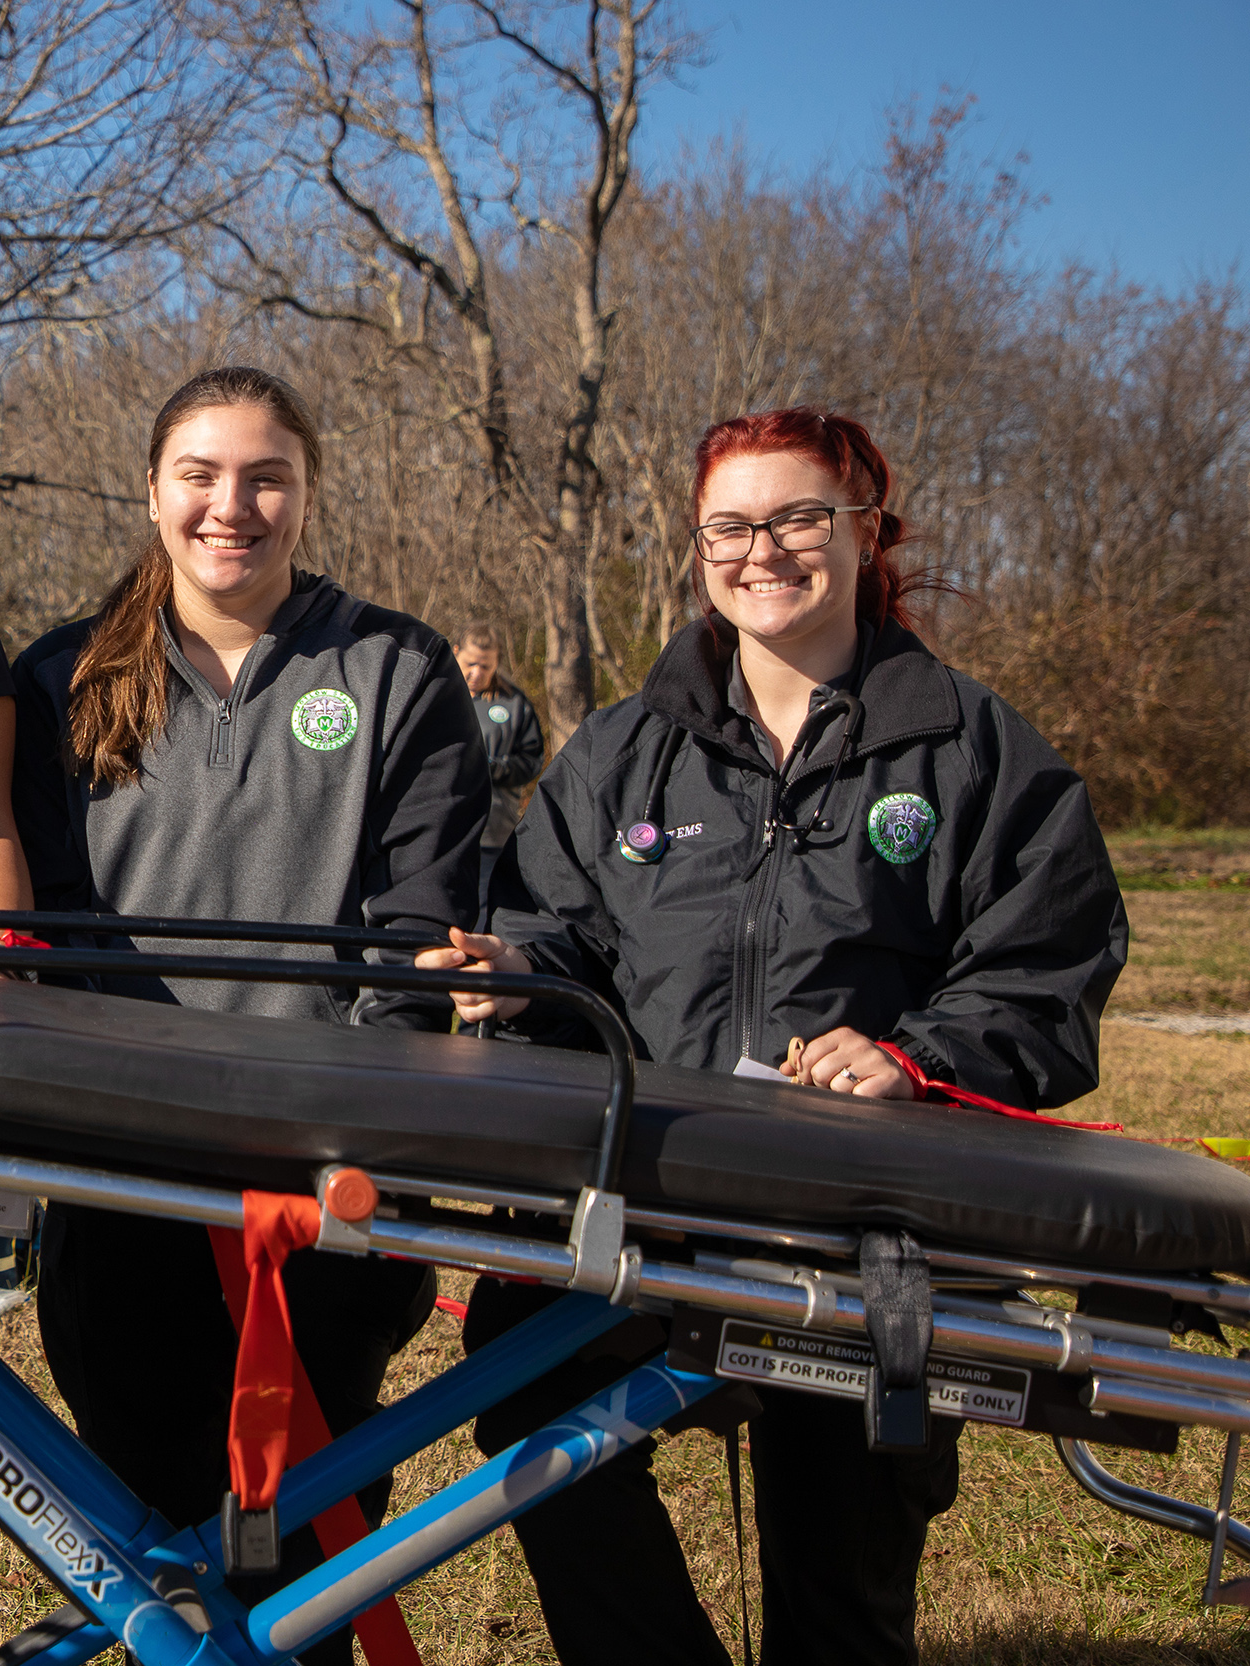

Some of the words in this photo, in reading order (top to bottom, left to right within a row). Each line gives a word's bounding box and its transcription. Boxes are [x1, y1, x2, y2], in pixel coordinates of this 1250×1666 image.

[319, 718, 330, 728] M
[676, 822, 703, 839] EMS
[896, 826, 908, 839] M
[777, 1336, 796, 1349] DO
[798, 1339, 825, 1354] NOT
[926, 1362, 945, 1374] ND
[947, 1366, 991, 1382] GUARD
[728, 1352, 759, 1368] COT
[761, 1356, 777, 1371] IS
[779, 1360, 812, 1378] FOR
[815, 1366, 866, 1386] PROFE
[938, 1388, 970, 1405] USE
[972, 1393, 1016, 1413] ONLY
